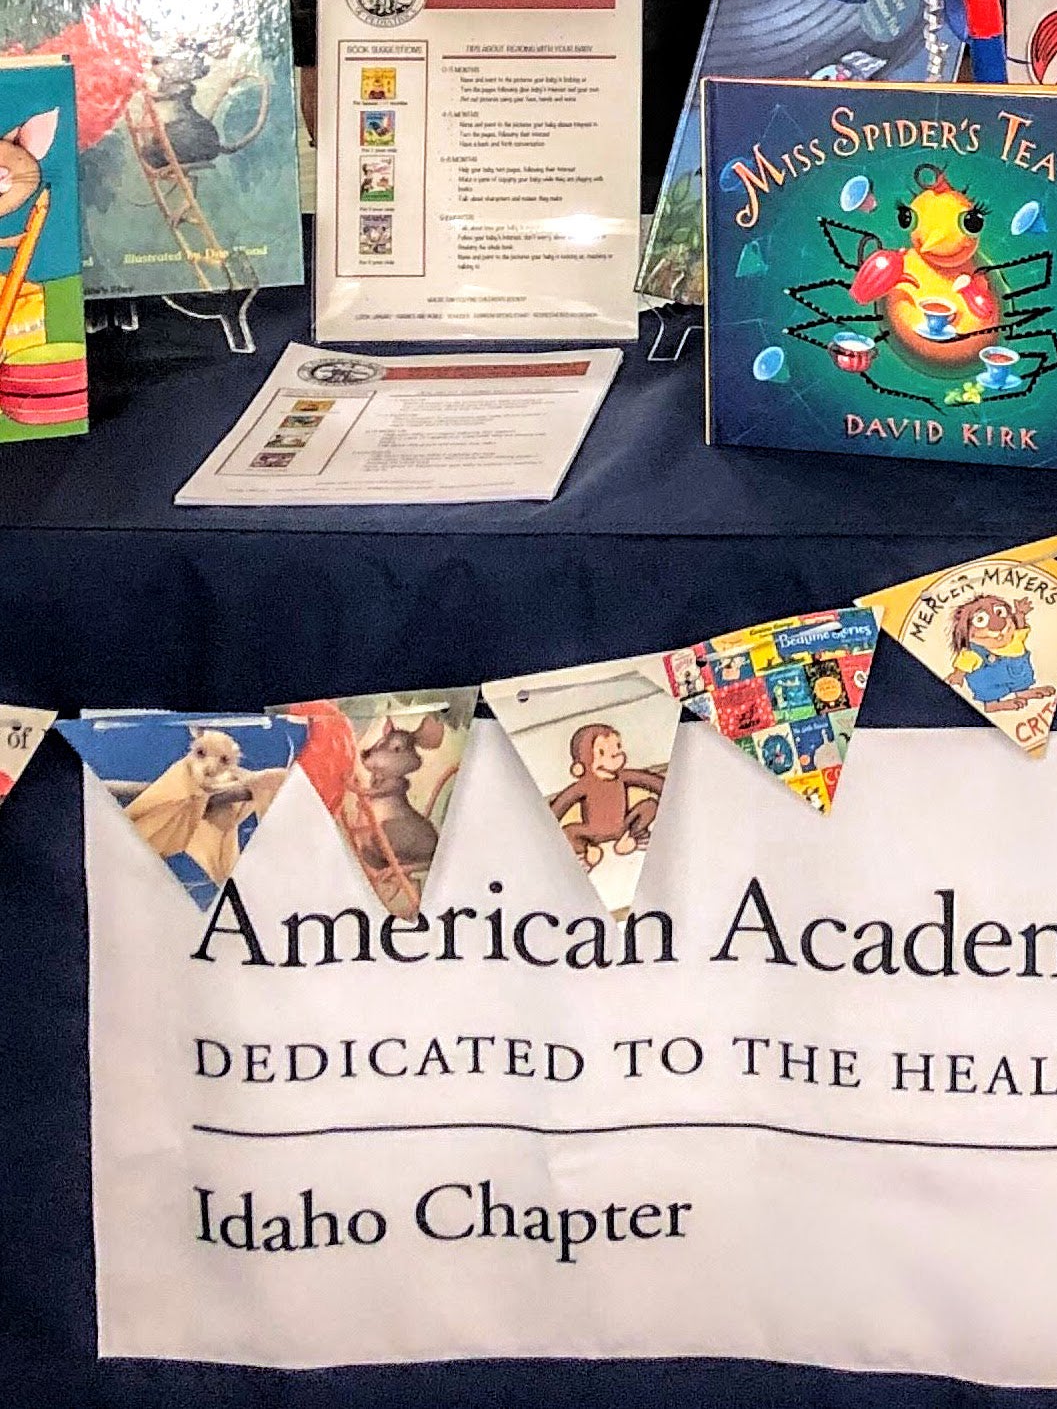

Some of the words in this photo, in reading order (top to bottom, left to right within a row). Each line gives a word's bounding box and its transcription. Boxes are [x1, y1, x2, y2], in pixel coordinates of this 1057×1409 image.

[844, 412, 945, 446] DAVID
[962, 420, 1040, 452] KIRK
[189, 876, 677, 969] American
[192, 1034, 585, 1085] DEDICATED
[614, 1035, 705, 1079] TO
[732, 1035, 862, 1089] THE
[192, 1185, 388, 1254] Idaho
[414, 1178, 693, 1265] Chapter
